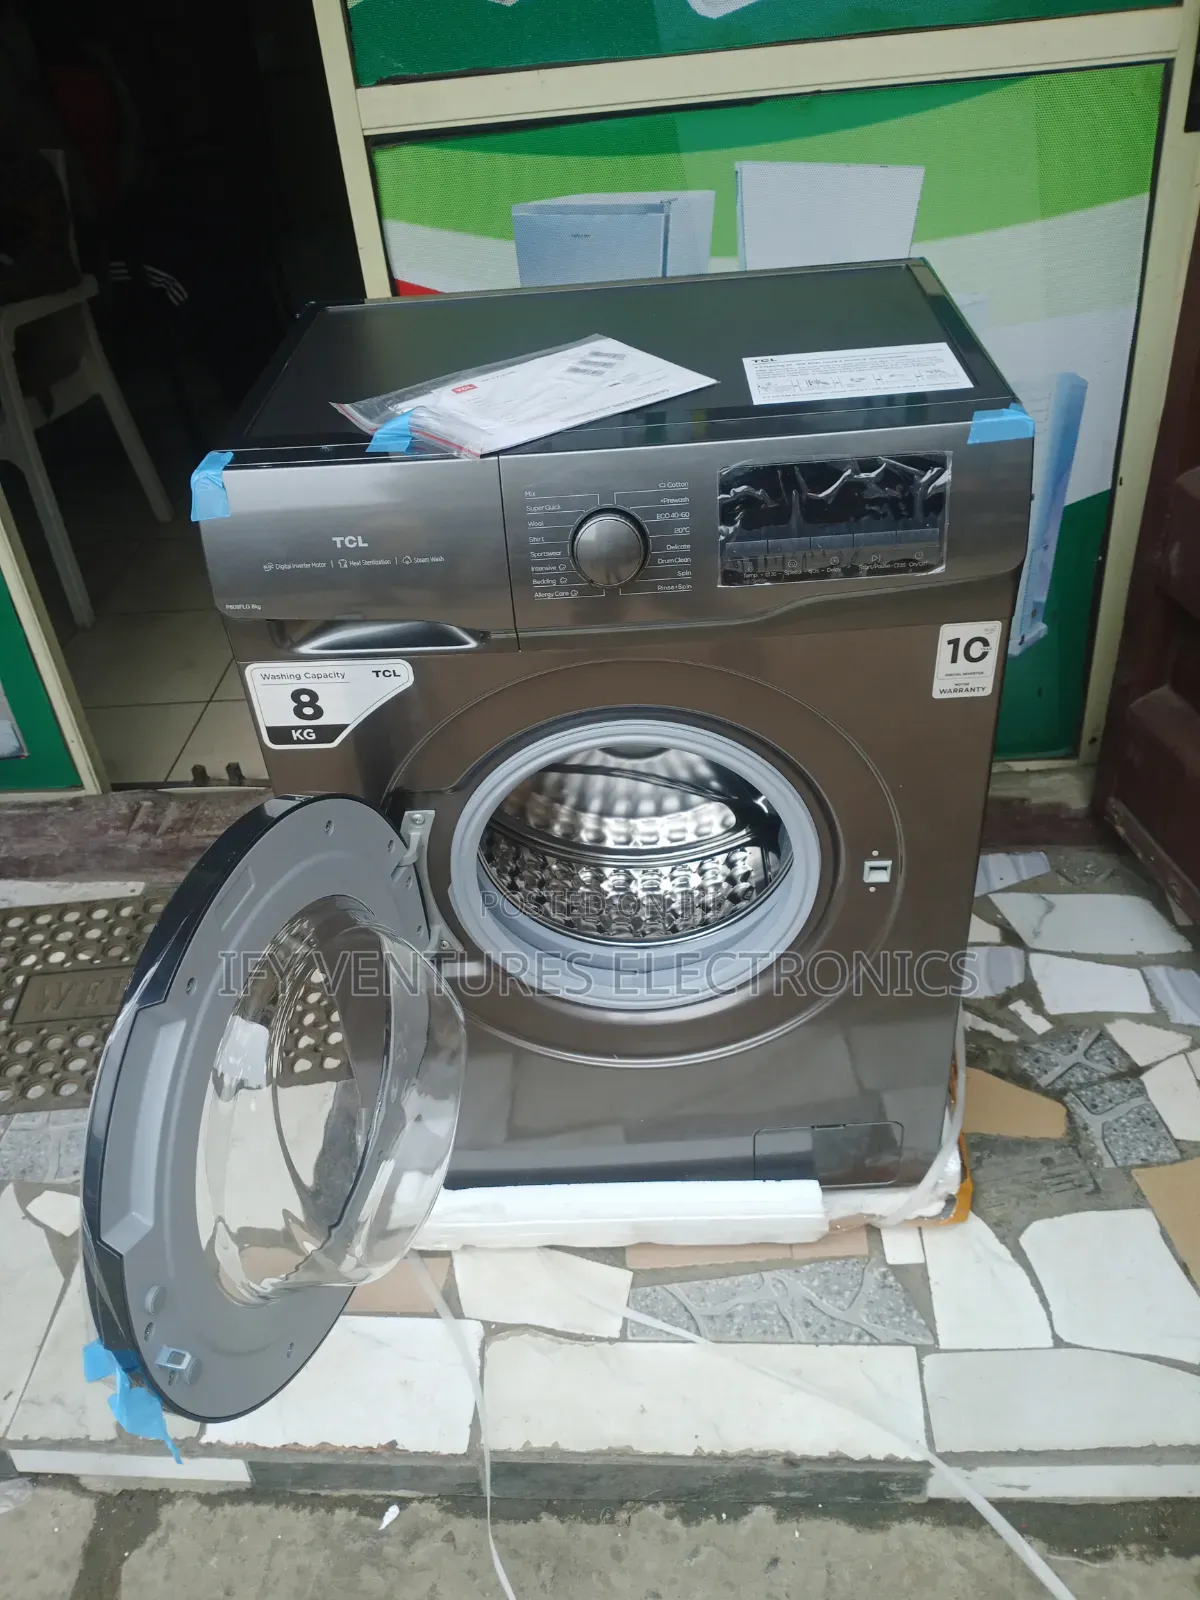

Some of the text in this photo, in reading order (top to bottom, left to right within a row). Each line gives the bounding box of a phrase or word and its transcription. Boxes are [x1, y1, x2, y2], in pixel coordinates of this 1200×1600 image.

[526, 504, 544, 512] Super
[656, 512, 670, 520] ECO
[528, 520, 544, 528] Wool
[332, 536, 368, 549] TCL
[530, 550, 562, 558] Sportswear
[362, 558, 392, 566] Sterilization
[413, 556, 430, 564] Steam
[674, 556, 691, 564] Clean
[275, 562, 291, 570] Digital
[292, 562, 311, 570] Inverter
[531, 564, 557, 572] Intensive
[532, 578, 556, 586] Bedding
[947, 636, 990, 664] 10
[260, 671, 346, 681] Washing Capacity
[372, 669, 401, 678] TCL
[939, 686, 986, 694] WARRANTY
[290, 688, 324, 721] 8
[291, 728, 316, 741] KG
